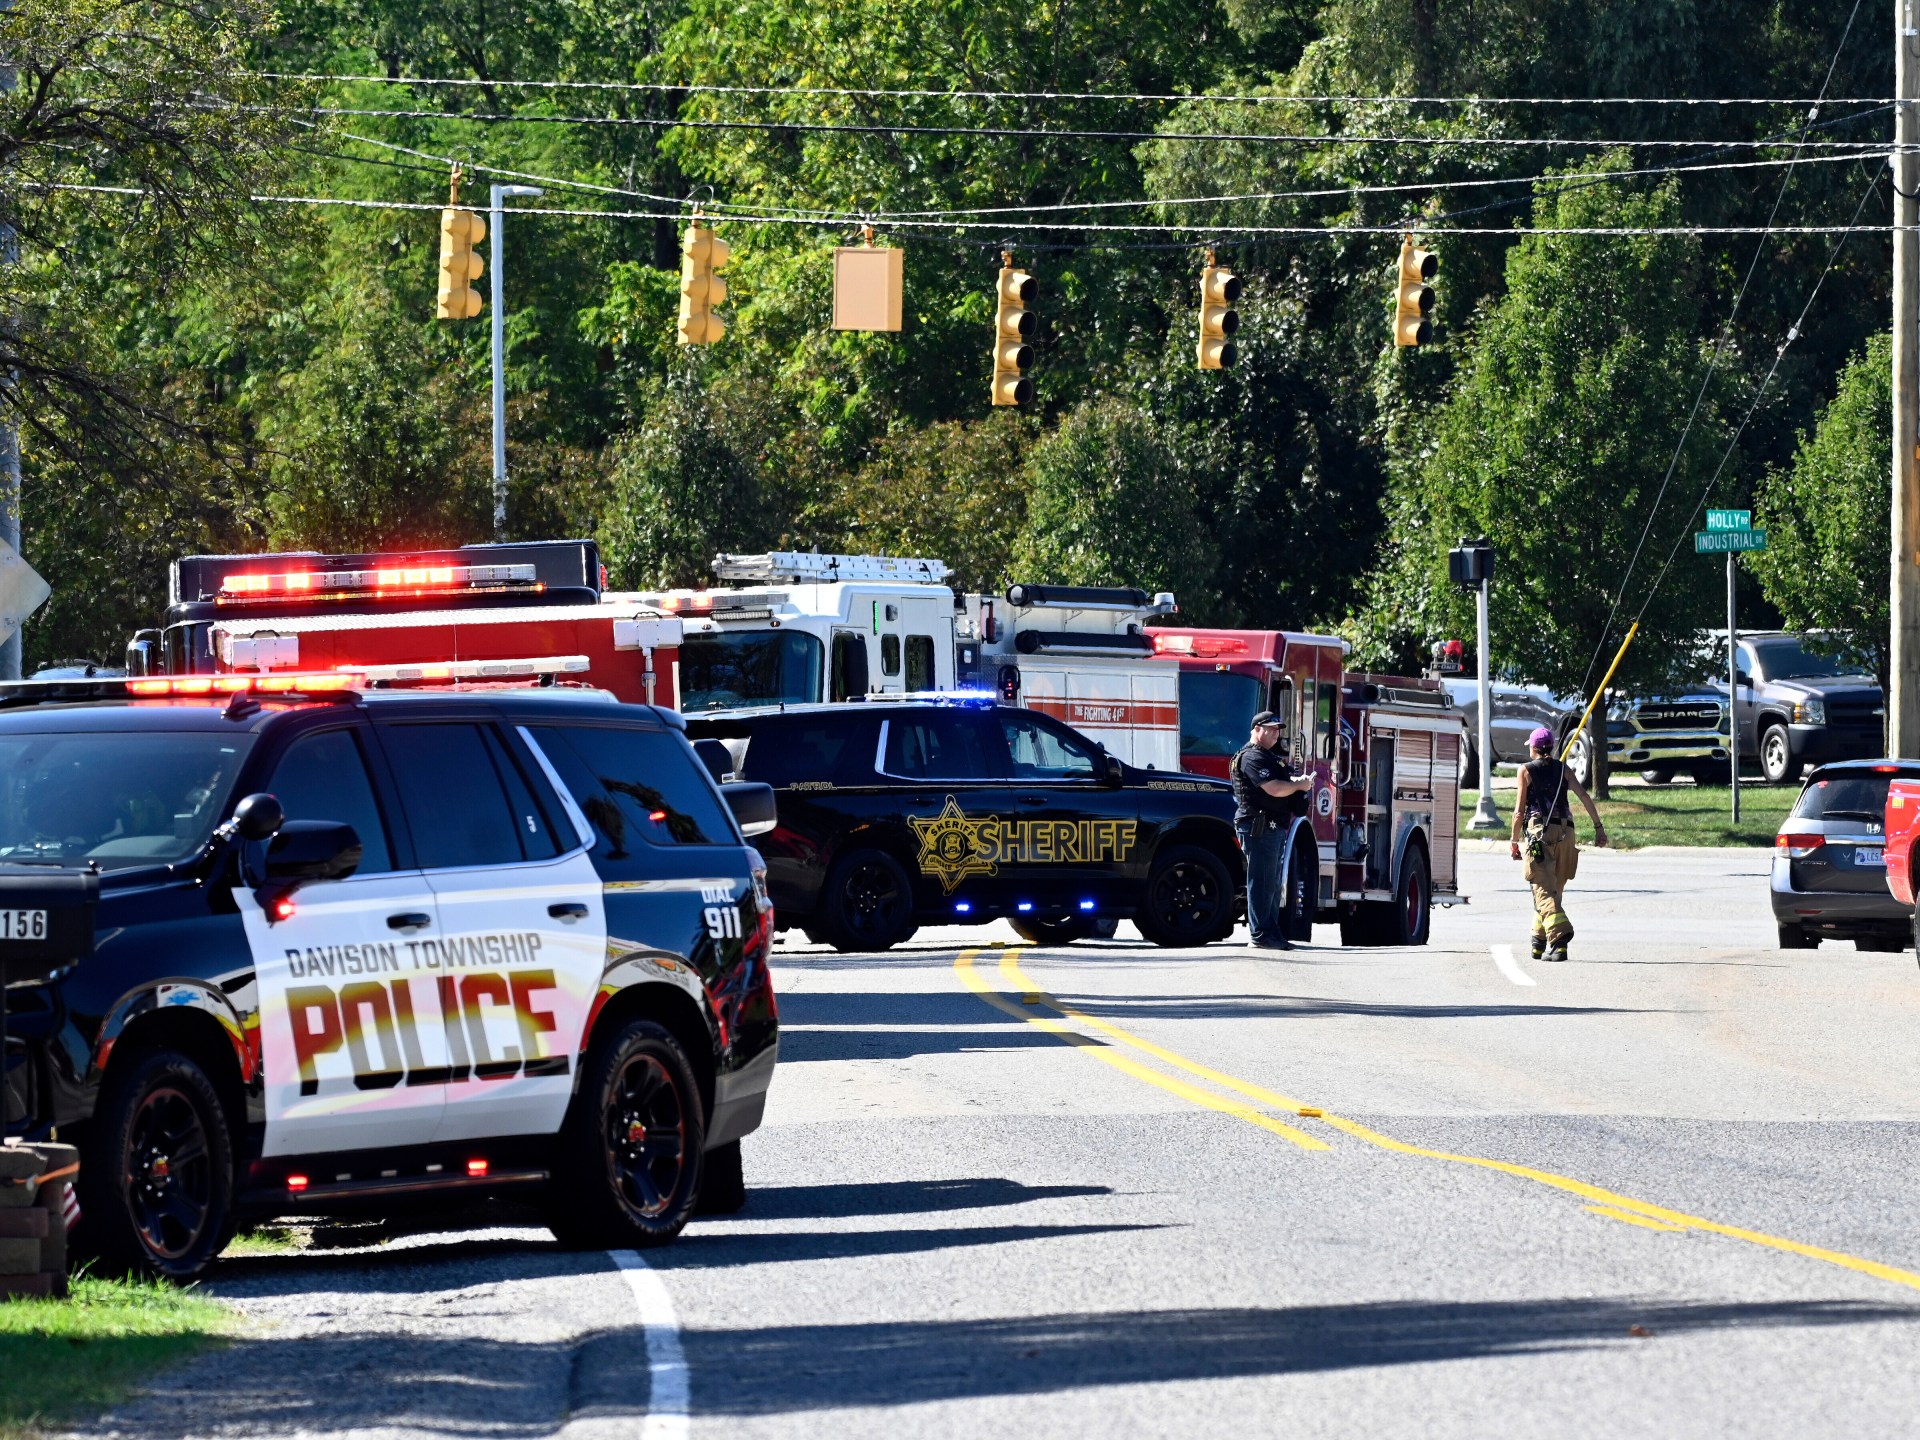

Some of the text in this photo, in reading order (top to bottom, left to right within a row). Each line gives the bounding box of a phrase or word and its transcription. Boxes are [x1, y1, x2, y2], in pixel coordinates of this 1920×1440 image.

[1708, 513, 1740, 528] HOLLY
[1699, 533, 1755, 550] INDUSTRIAL
[1084, 706, 1111, 721] FIGHTING
[790, 782, 838, 791] PATROL
[1321, 799, 1329, 812] 2
[931, 820, 976, 837] SHERIFF
[976, 821, 1138, 862] SHERIFF
[700, 886, 735, 903] DIAL
[3, 911, 43, 937] 156
[704, 907, 742, 938] 911
[284, 933, 542, 978] DAVISON TOWNSHIP
[285, 969, 570, 1096] POLICE
